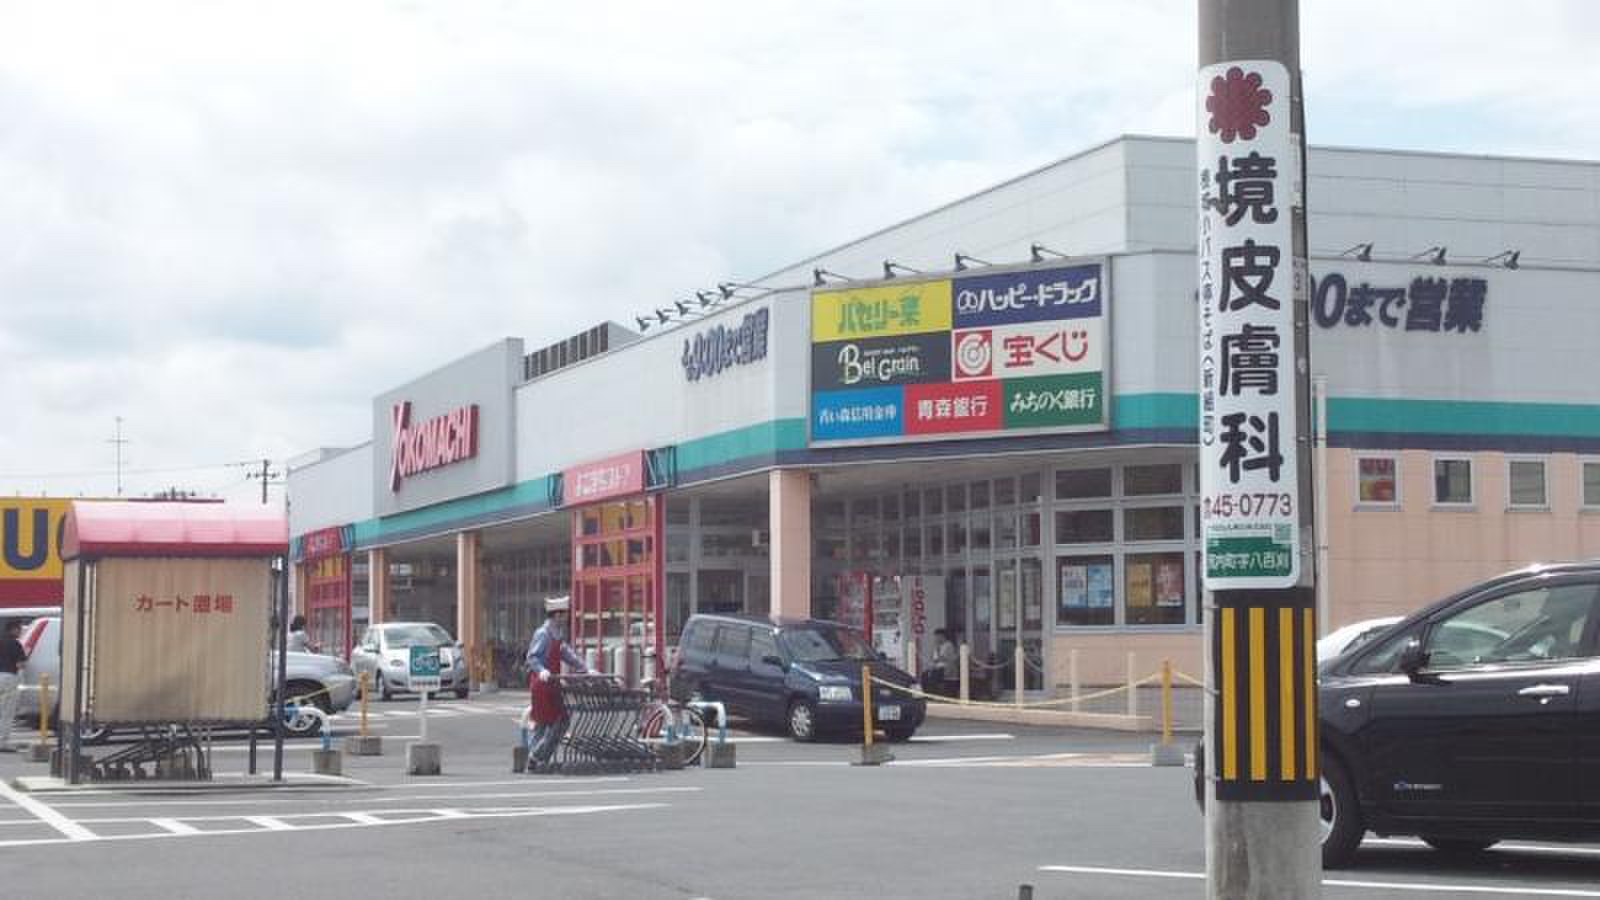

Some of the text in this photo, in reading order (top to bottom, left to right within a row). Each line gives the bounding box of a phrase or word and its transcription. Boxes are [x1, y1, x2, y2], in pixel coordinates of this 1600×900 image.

[1216, 152, 1284, 483] 境皮膚科
[838, 344, 920, 384] Bel Grain
[1003, 330, 1088, 368] 宝くじ
[918, 395, 988, 420] 青森銀行
[1010, 388, 1096, 413] みちのく銀行
[389, 400, 480, 492] YOKOMACHI
[1212, 493, 1292, 517] 45-0773
